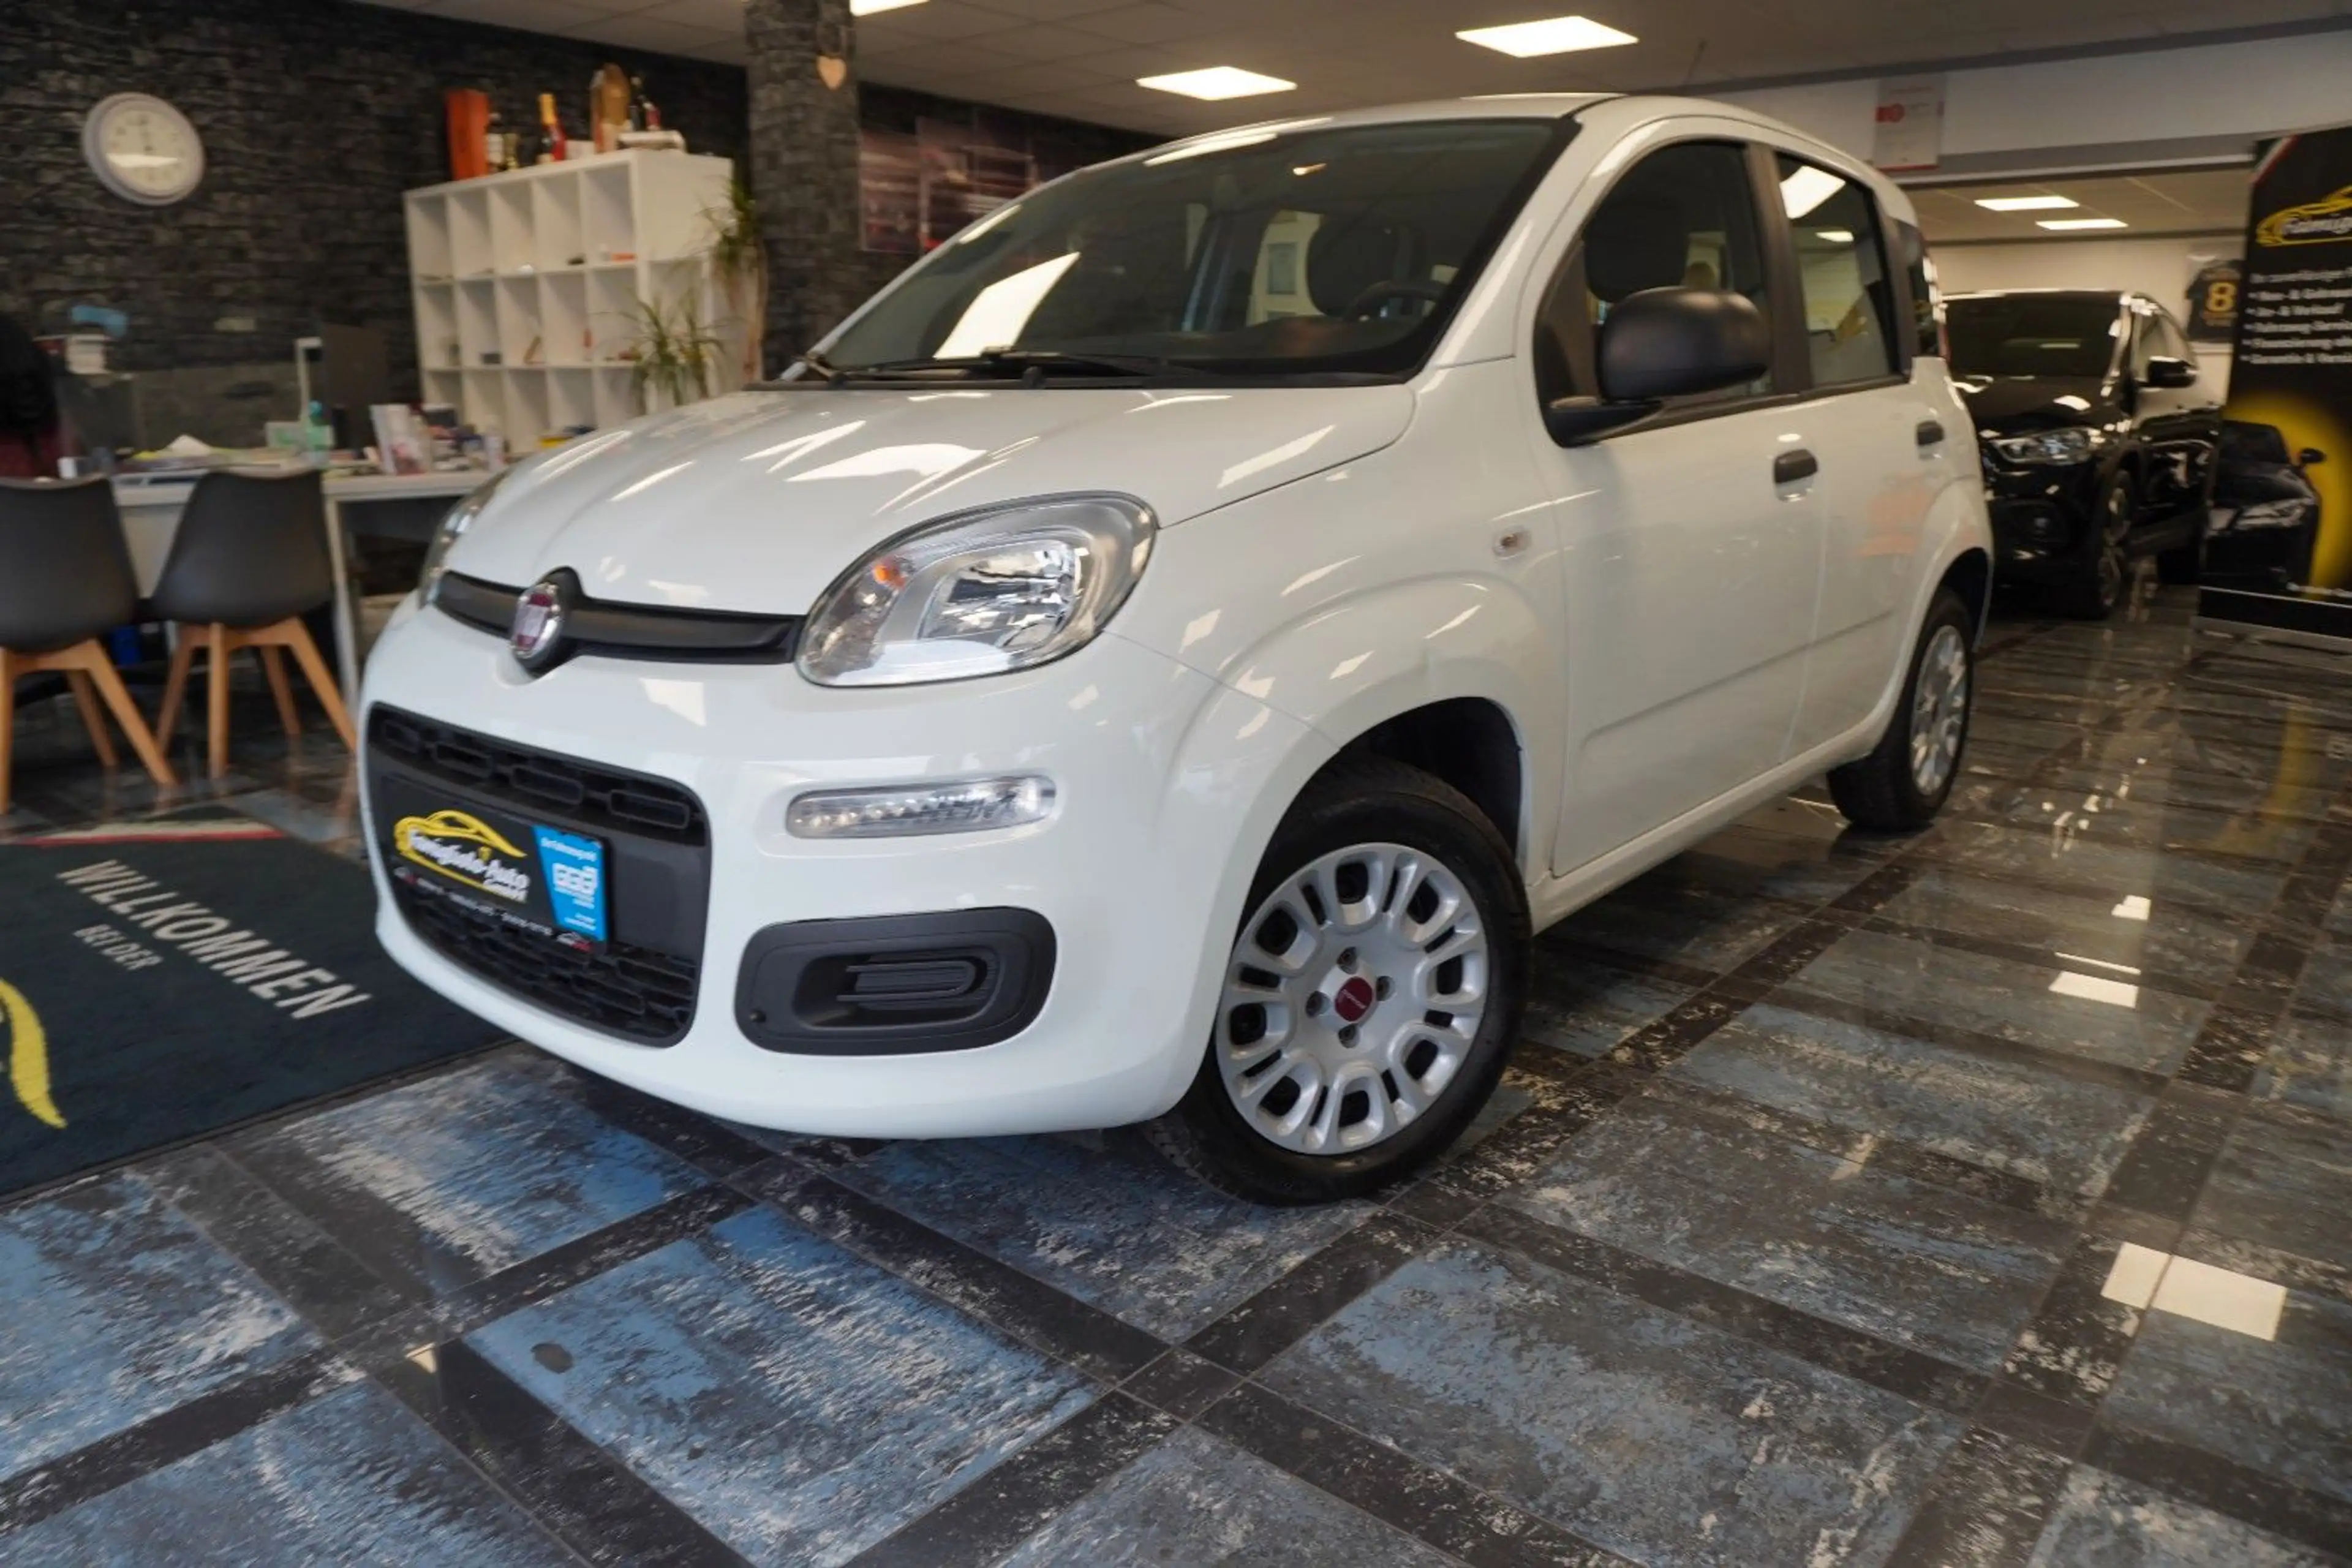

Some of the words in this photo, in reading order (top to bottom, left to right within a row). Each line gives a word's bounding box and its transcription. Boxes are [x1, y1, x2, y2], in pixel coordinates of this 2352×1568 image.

[2206, 282, 2236, 311] 8
[56, 859, 372, 1020] WILLKOMMEN
[72, 924, 127, 947] BEI
[100, 943, 164, 971] DER
